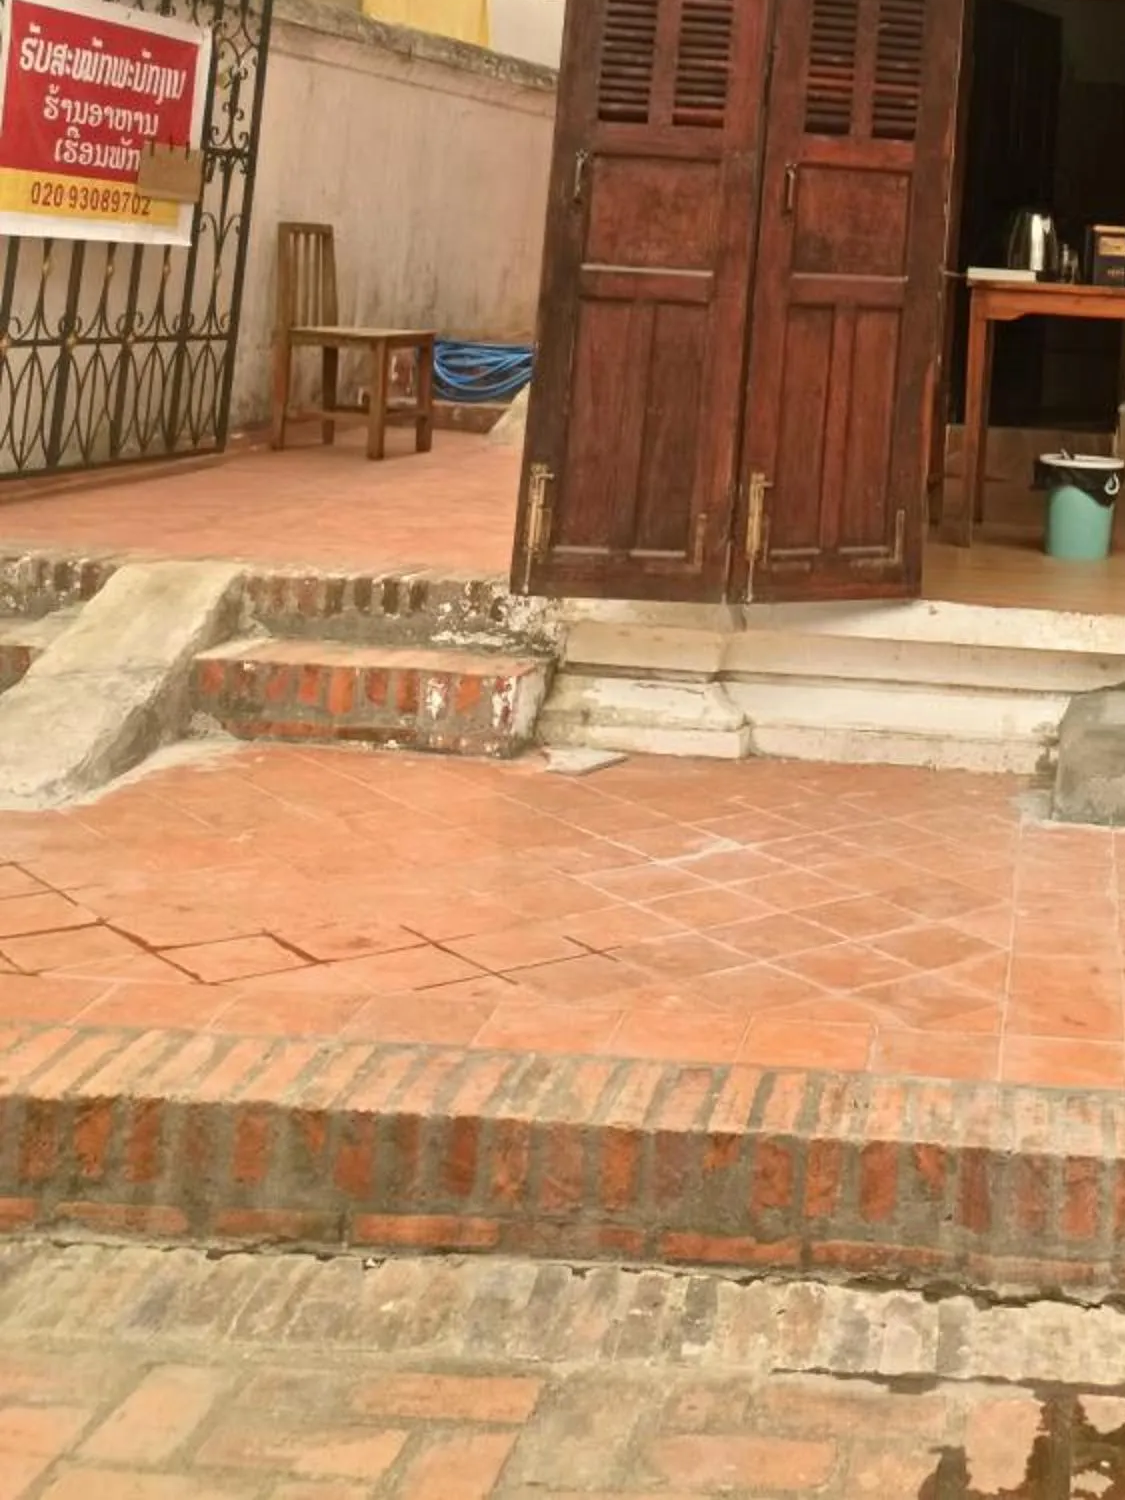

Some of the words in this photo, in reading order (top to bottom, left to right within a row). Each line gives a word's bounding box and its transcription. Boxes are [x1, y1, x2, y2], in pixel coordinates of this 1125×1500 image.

[43, 83, 159, 136] ຮ້ານອາຫານ
[31, 181, 65, 207] 020
[68, 185, 152, 216] 93089702
